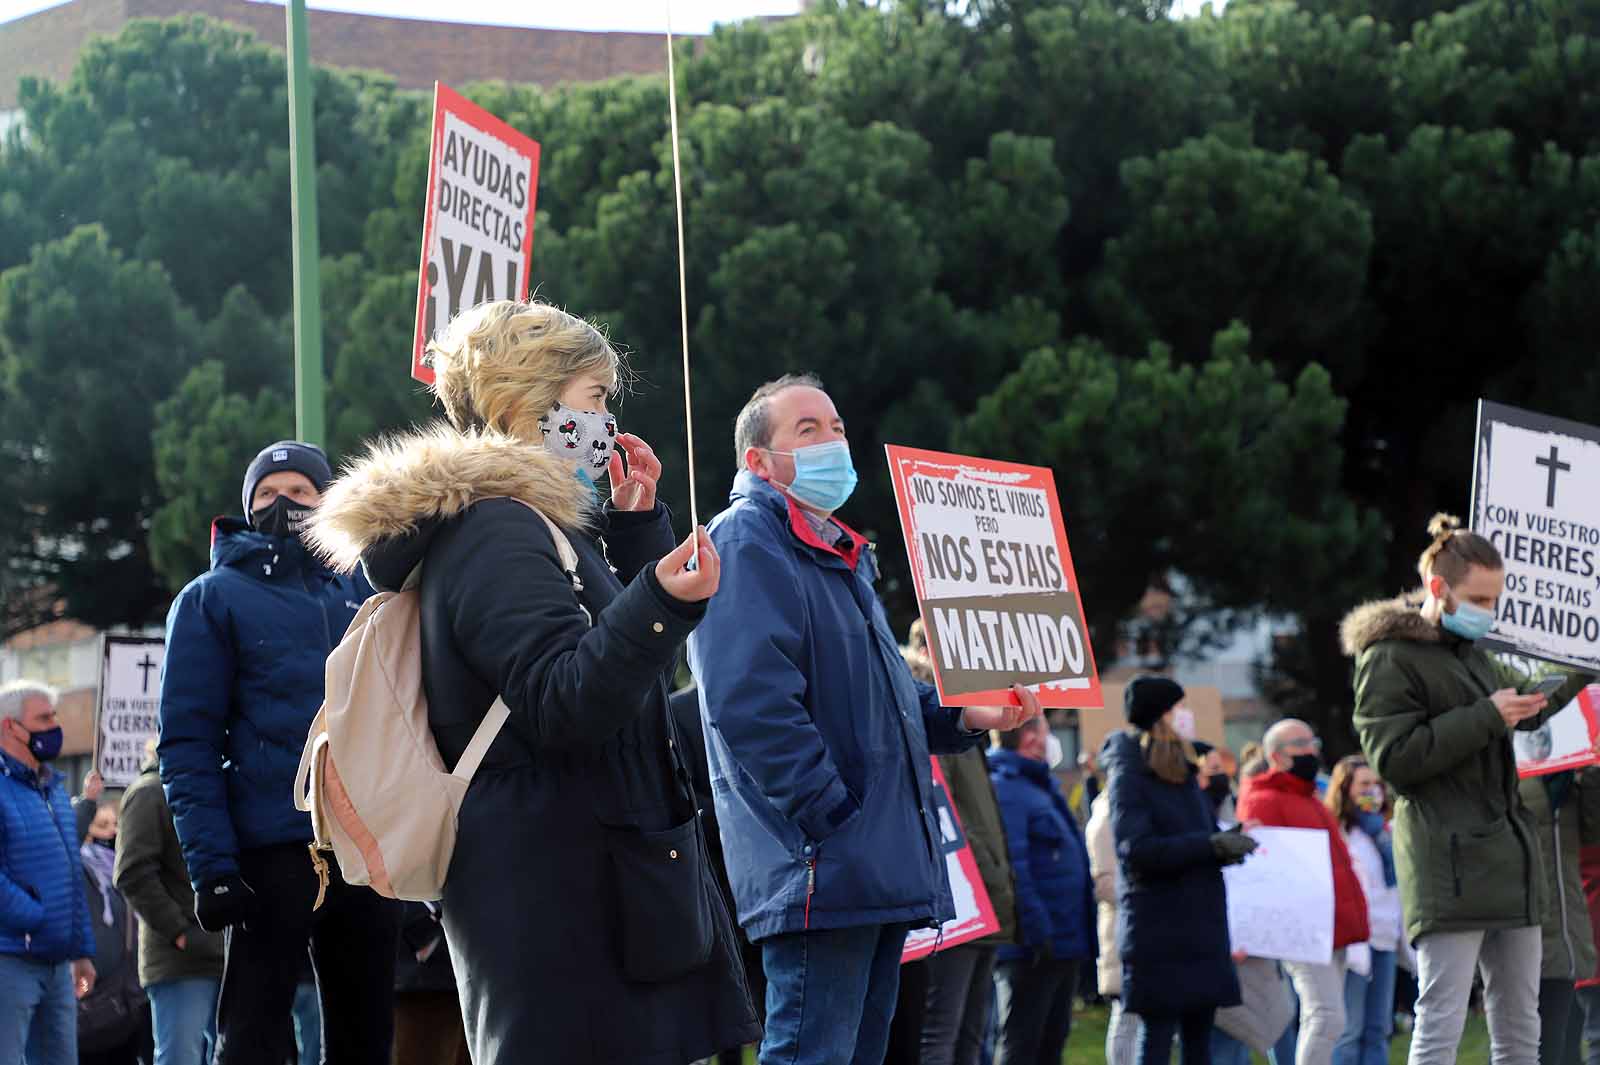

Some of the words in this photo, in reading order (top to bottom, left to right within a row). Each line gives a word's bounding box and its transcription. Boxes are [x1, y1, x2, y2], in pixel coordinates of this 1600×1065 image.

[443, 131, 526, 209] AYUDAS
[439, 178, 522, 253] DIRECTAS
[913, 477, 935, 505] NO
[938, 481, 986, 512] SOMOS
[987, 488, 1006, 513] EL
[1006, 489, 1045, 518] VIRUS
[975, 515, 999, 534] PERO
[1487, 504, 1519, 527] CON
[1526, 512, 1600, 545] VUESTRO
[922, 532, 977, 583] NOS
[980, 539, 1063, 590] ESTAIS
[1505, 573, 1527, 593] OS
[1535, 579, 1591, 608] ESTAIS
[933, 607, 1085, 675] MATANDO
[104, 756, 142, 774] MATA
